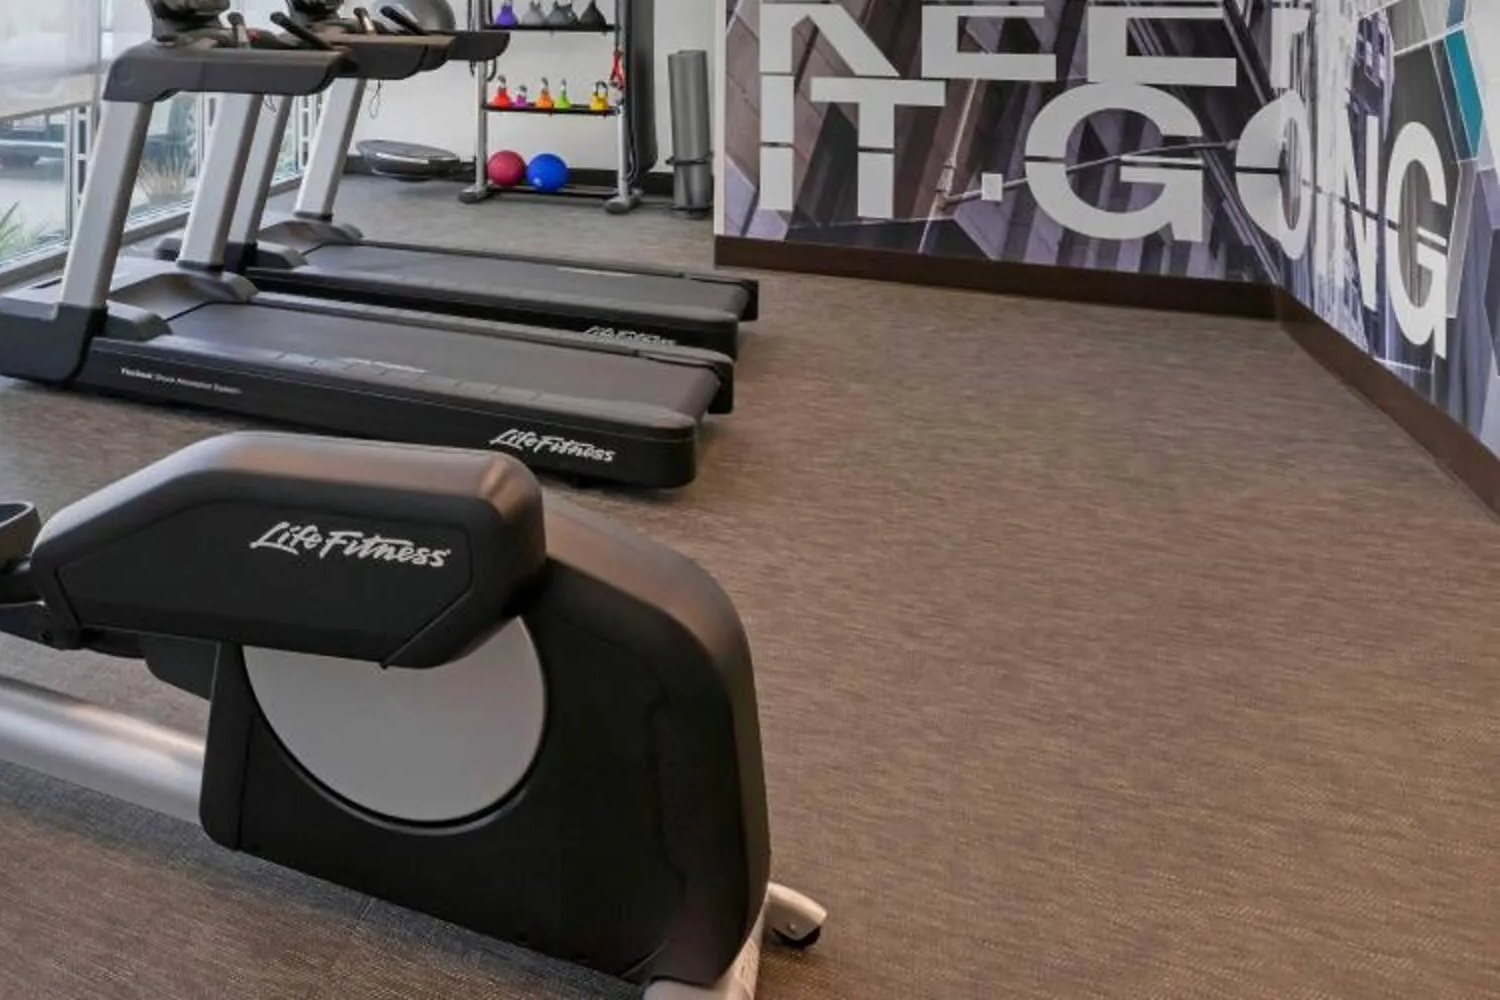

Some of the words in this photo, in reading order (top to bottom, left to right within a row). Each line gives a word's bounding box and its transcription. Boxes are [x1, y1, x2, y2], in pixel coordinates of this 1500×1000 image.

[760, 74, 946, 219] IT
[1024, 82, 1448, 358] GOING
[489, 428, 538, 451] Life
[533, 435, 617, 462] Fitness
[250, 521, 323, 556] Life
[319, 531, 451, 567] Fitness
